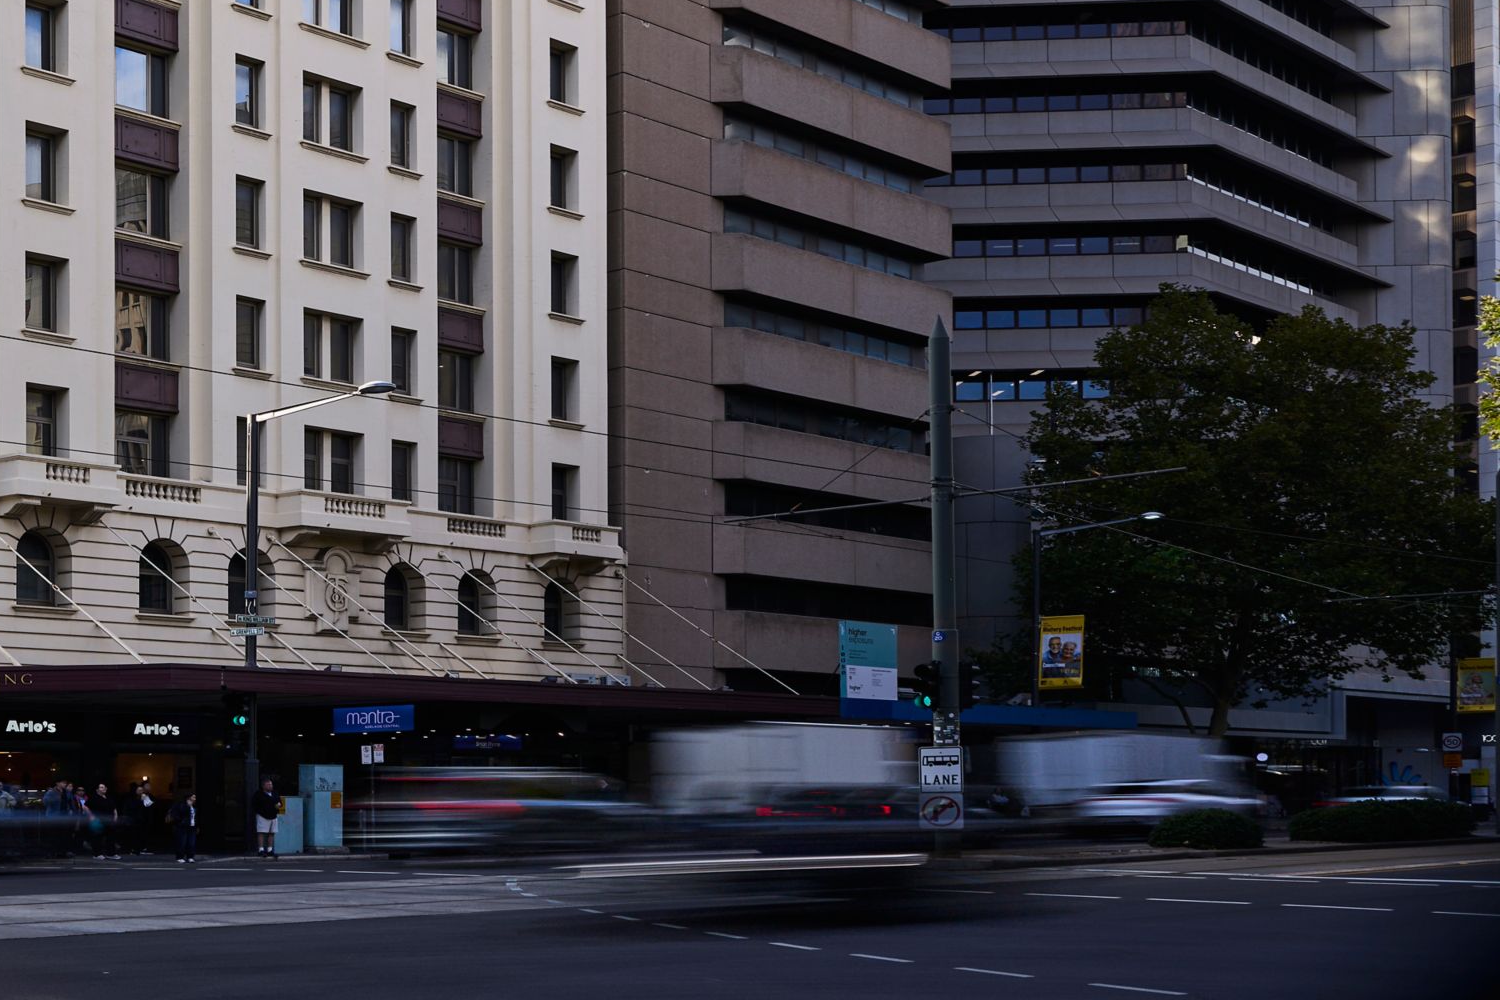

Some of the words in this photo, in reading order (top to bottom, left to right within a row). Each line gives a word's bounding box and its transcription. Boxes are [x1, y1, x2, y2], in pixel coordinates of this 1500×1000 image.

[346, 709, 401, 725] mantra
[5, 719, 57, 733] Arlo's
[133, 722, 180, 736] Arlo's
[924, 774, 959, 785] LANE
